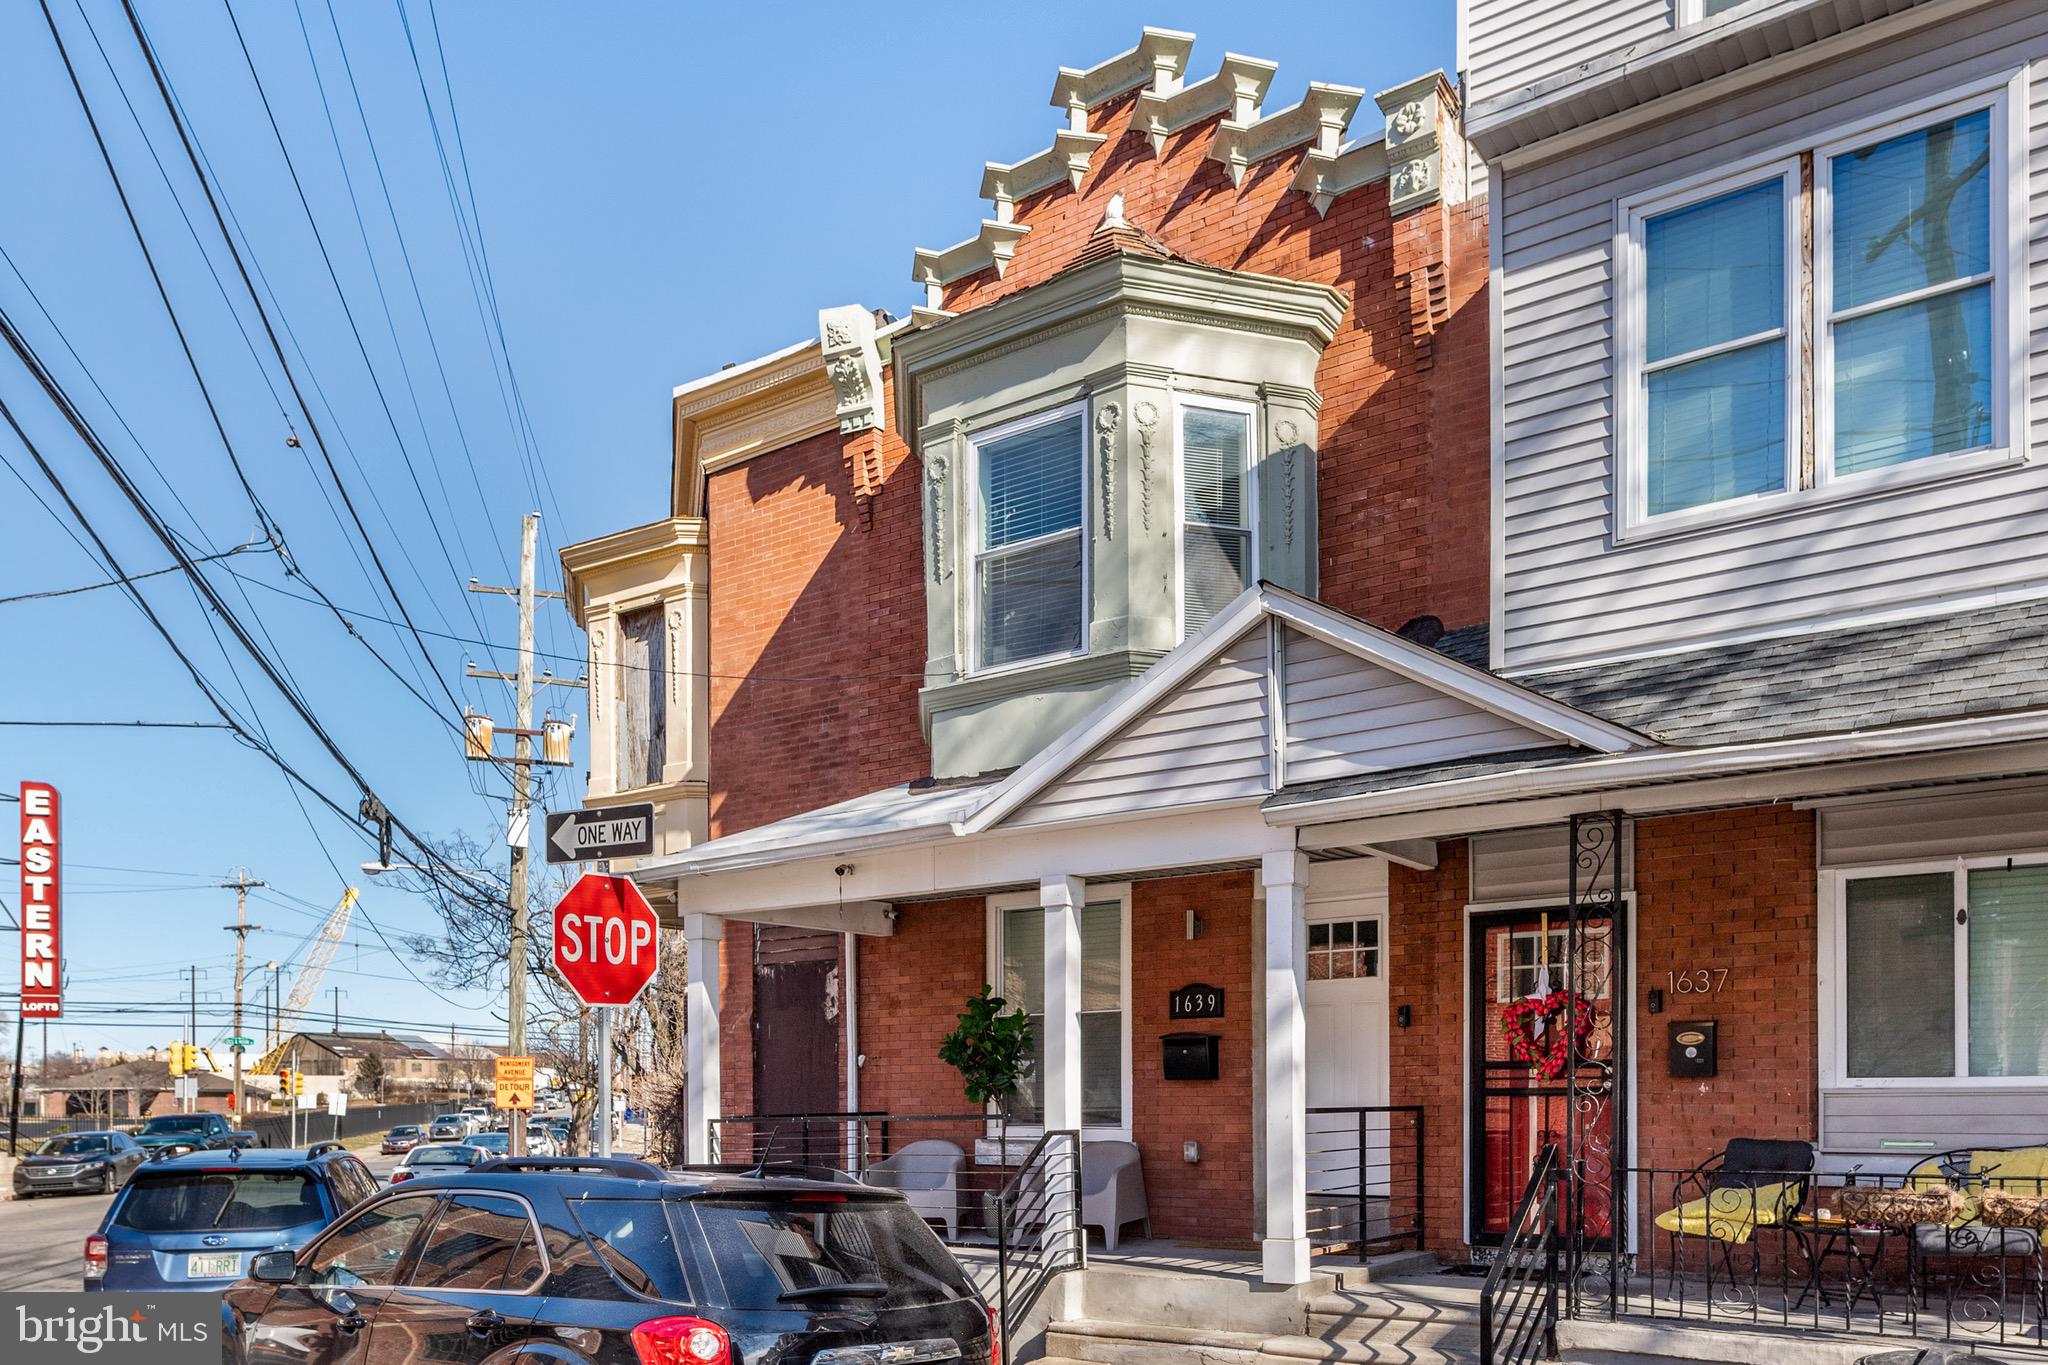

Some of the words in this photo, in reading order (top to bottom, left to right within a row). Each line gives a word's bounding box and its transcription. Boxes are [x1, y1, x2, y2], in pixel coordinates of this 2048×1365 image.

[577, 824, 607, 846] ONE
[611, 820, 642, 842] WAY
[23, 789, 55, 988] EASTERN
[560, 912, 651, 966] STOP
[1667, 968, 1729, 994] 1637
[22, 1002, 59, 1012] LOFTS
[1175, 994, 1216, 1013] 1639
[499, 1083, 530, 1091] DETOUR
